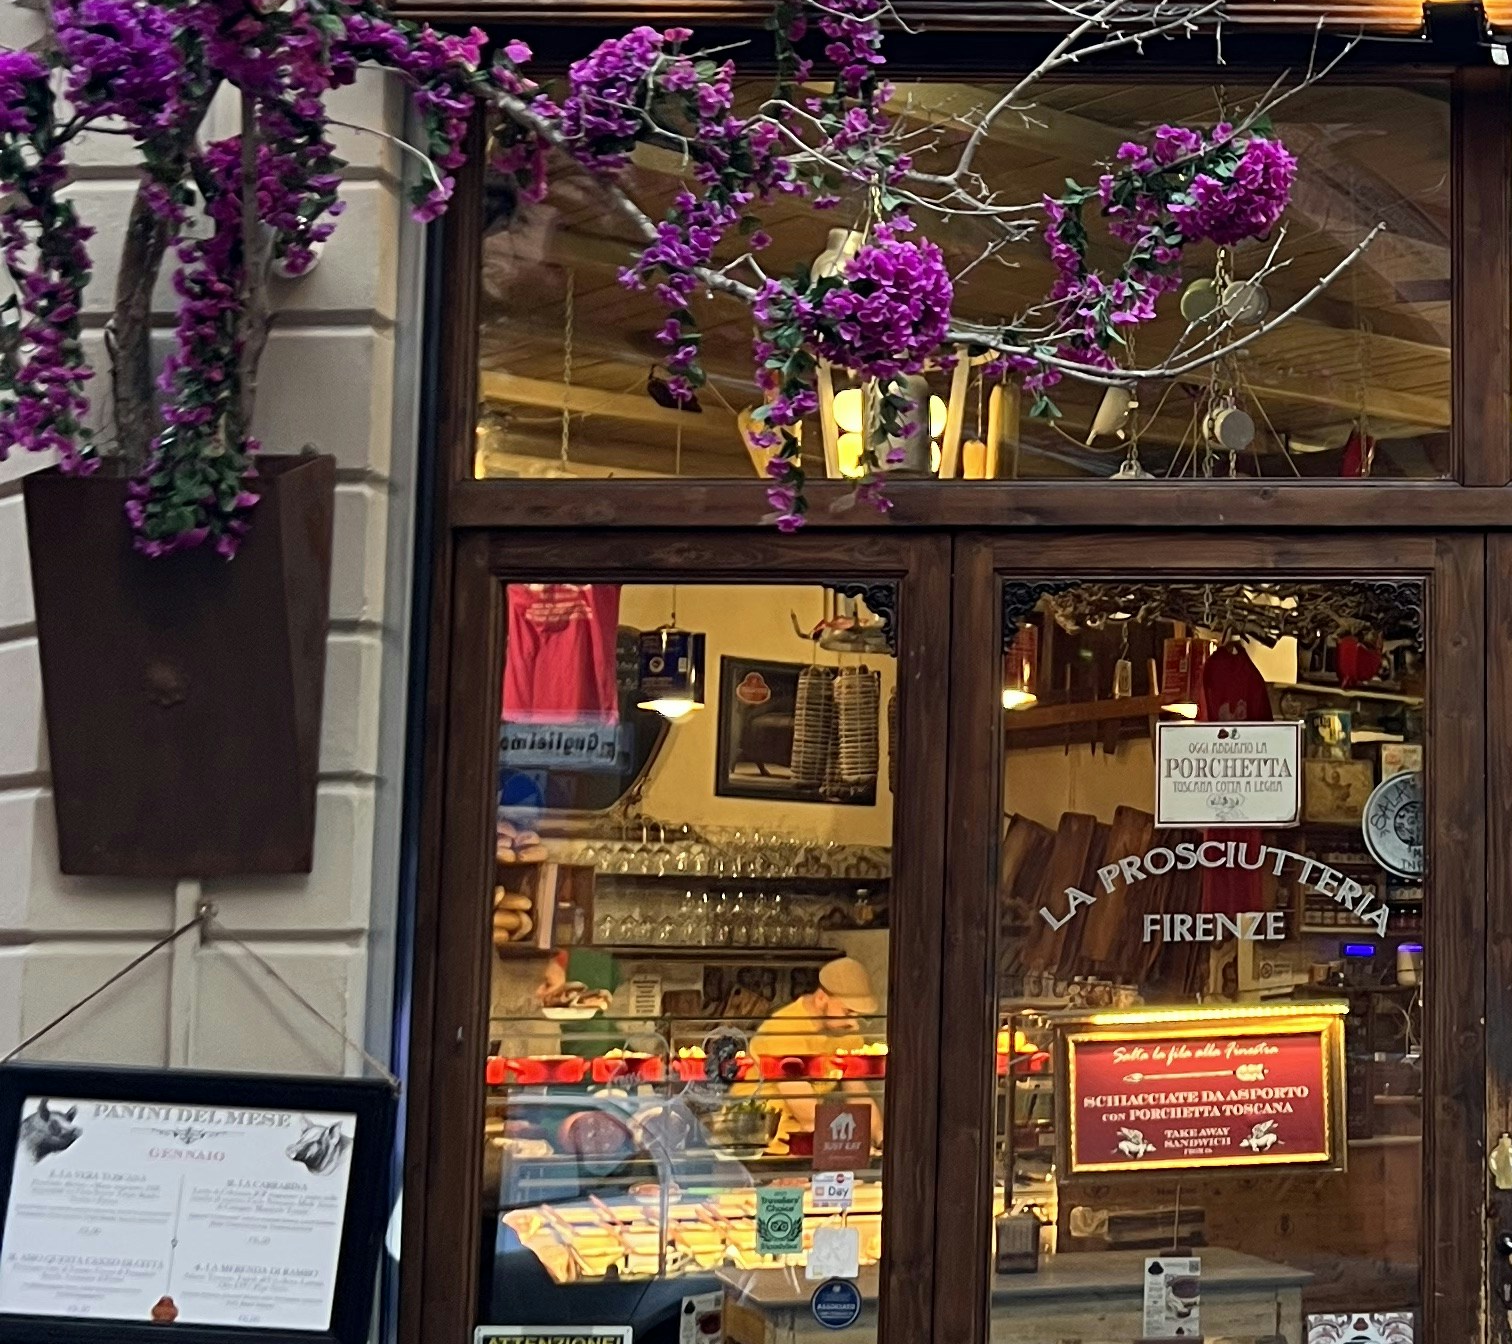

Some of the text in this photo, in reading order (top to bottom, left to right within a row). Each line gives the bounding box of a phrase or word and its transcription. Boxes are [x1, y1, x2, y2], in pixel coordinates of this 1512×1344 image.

[1189, 742, 1209, 754] OGGI
[1256, 742, 1267, 754] LA
[1164, 758, 1292, 778] PORCHETTA
[1173, 781, 1283, 793] TOSCANA COTTA A LEGNA
[1039, 841, 1390, 938] LA PROSCIUTTERIA
[1143, 912, 1285, 943] FIRENZE
[1166, 1044, 1192, 1066] fila
[1083, 1085, 1309, 1108] SCHIACCIATE DA ASPORTO
[93, 1103, 292, 1128] PANINI DEL MESE
[1129, 1105, 1221, 1121] PORCHETTA
[1222, 1101, 1294, 1116] TOSCANA
[1164, 1127, 1231, 1138] TAKE AWAY
[1164, 1137, 1231, 1148] SANDWICH
[149, 1147, 226, 1161] GENNAIO
[828, 1185, 850, 1199] Day
